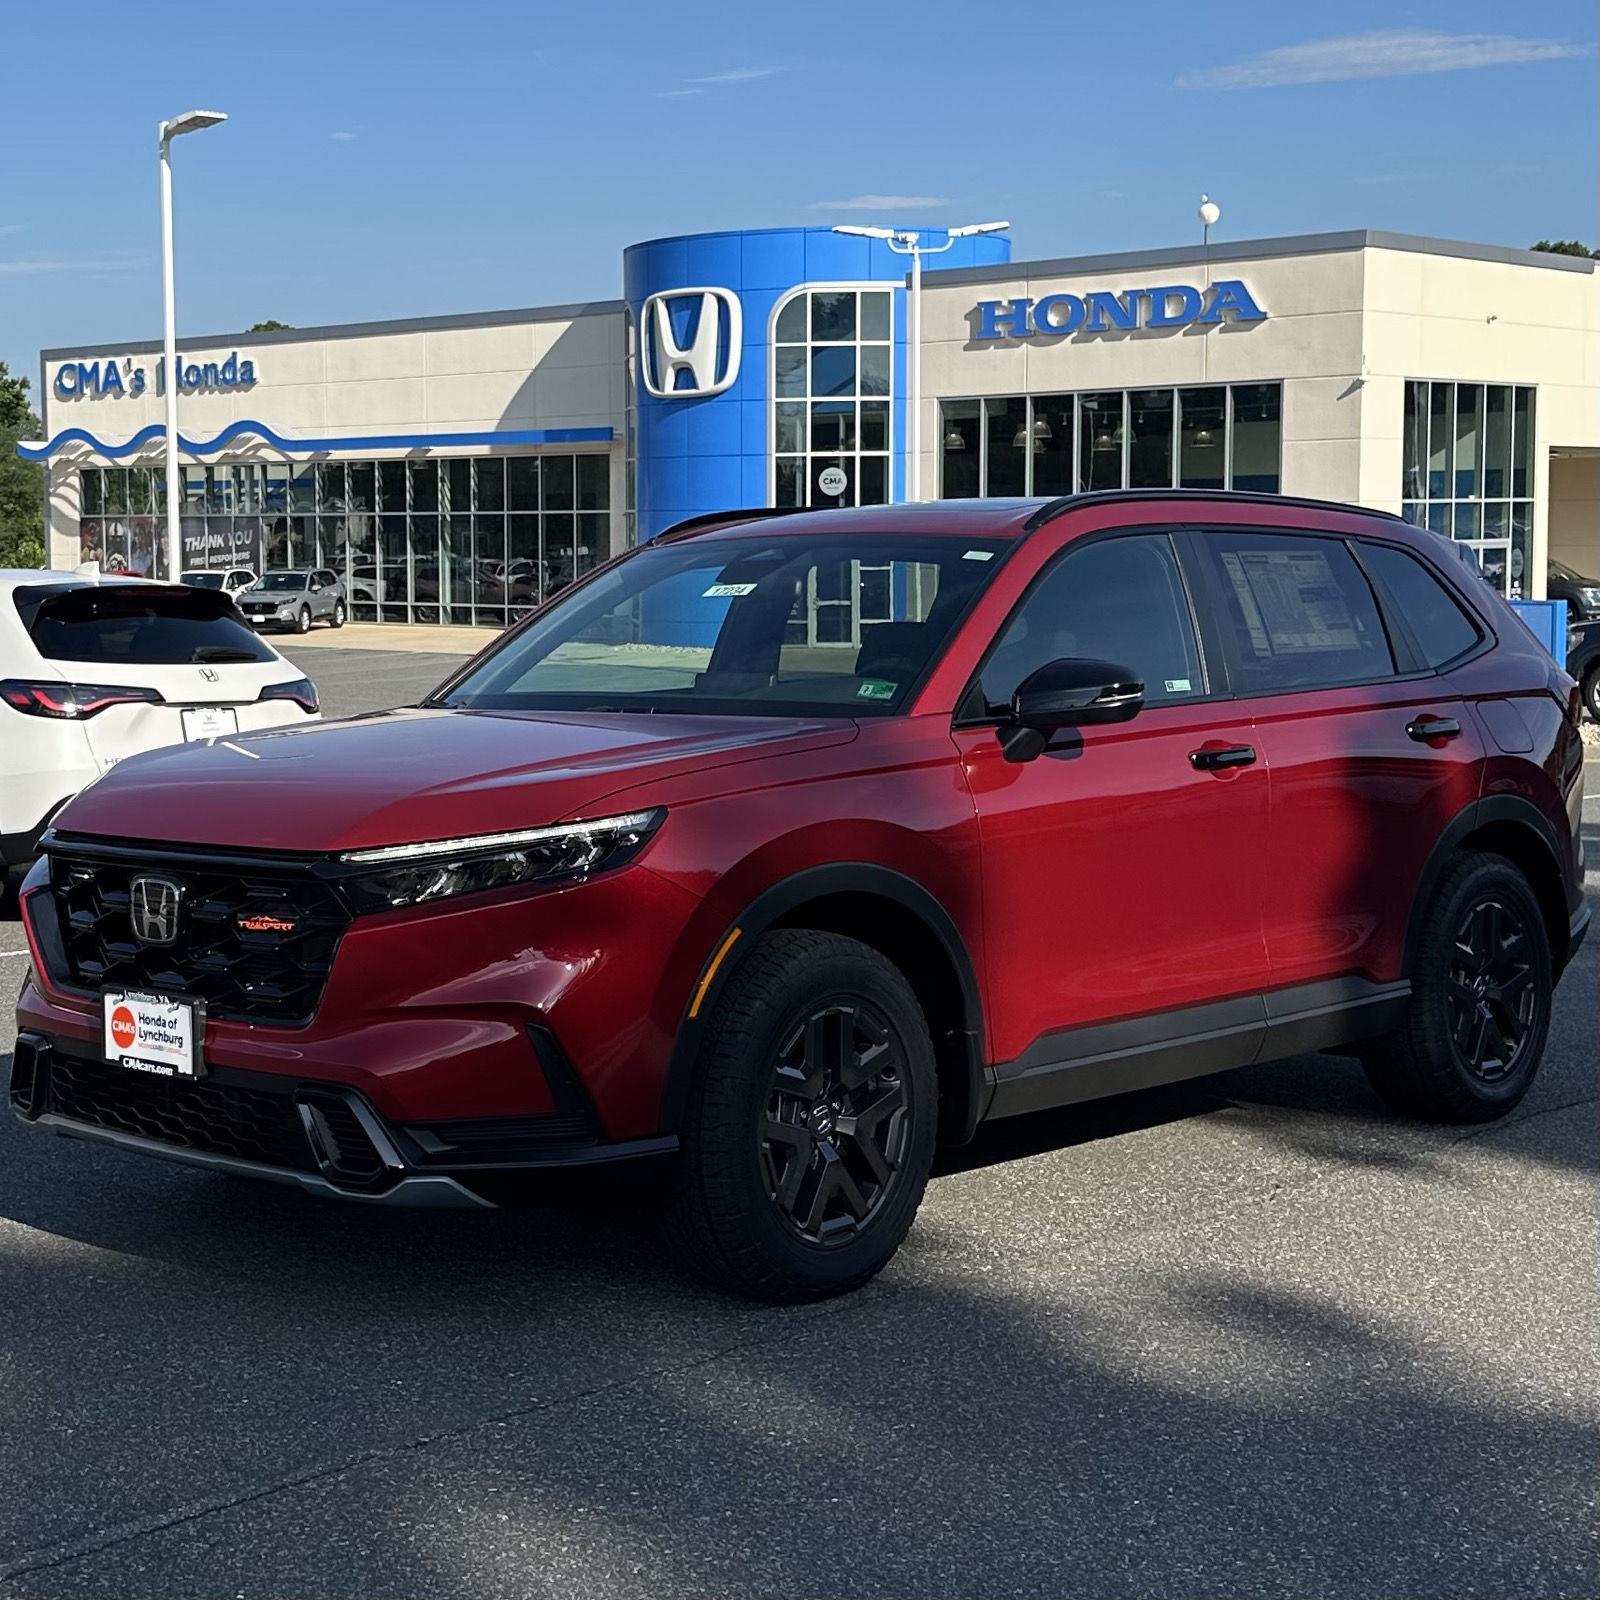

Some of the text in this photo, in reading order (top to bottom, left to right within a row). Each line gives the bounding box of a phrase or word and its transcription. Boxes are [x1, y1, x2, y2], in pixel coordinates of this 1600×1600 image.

[976, 280, 1267, 340] HONDA
[57, 358, 145, 395] CMA's
[185, 529, 253, 552] THANK YOU
[138, 1012, 177, 1030] Honda of
[138, 1027, 184, 1048] Lynchburg
[122, 1058, 174, 1076] CMAcars.com
